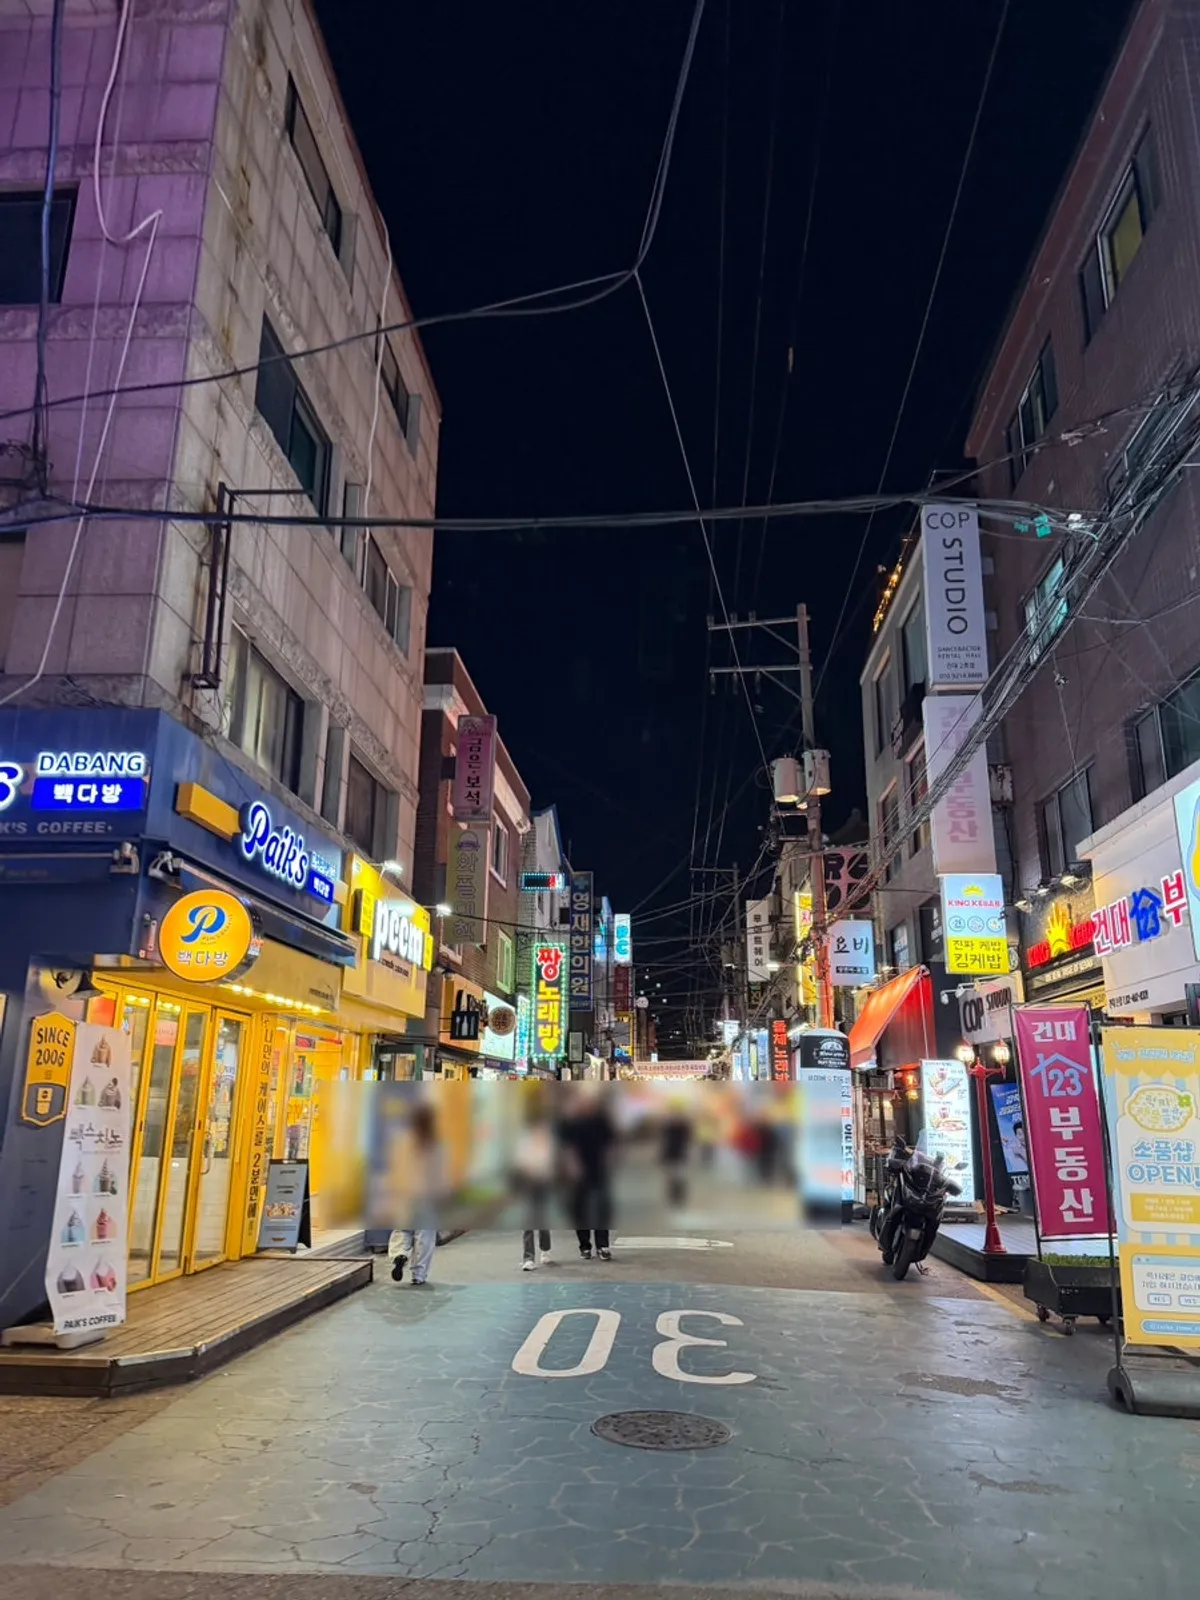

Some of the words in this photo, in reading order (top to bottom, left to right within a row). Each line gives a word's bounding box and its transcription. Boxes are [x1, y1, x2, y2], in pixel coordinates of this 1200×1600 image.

[926, 512, 971, 530] COP
[943, 538, 968, 635] STUDIO
[39, 753, 144, 772] DABANG
[37, 821, 107, 834] COFFEE
[243, 803, 308, 887] Paik's
[455, 853, 478, 940] 와플대학
[948, 899, 970, 908] KING
[971, 899, 1001, 908] KEBAB
[1093, 898, 1132, 956] 건대
[834, 935, 869, 955] 요비
[537, 948, 563, 981] 짱
[954, 953, 1002, 969] 킹케밥
[537, 980, 562, 1039] 노래방
[963, 997, 985, 1033] COP
[37, 1027, 71, 1048] SINCE
[1031, 1020, 1077, 1043] 건대
[36, 1048, 66, 1067] 2006
[1133, 1140, 1194, 1163] 소품샵
[1049, 1106, 1095, 1224] 부동산
[1127, 1163, 1200, 1190] OPEN!
[88, 1313, 117, 1326] COFFEE
[511, 1308, 758, 1386] 30
